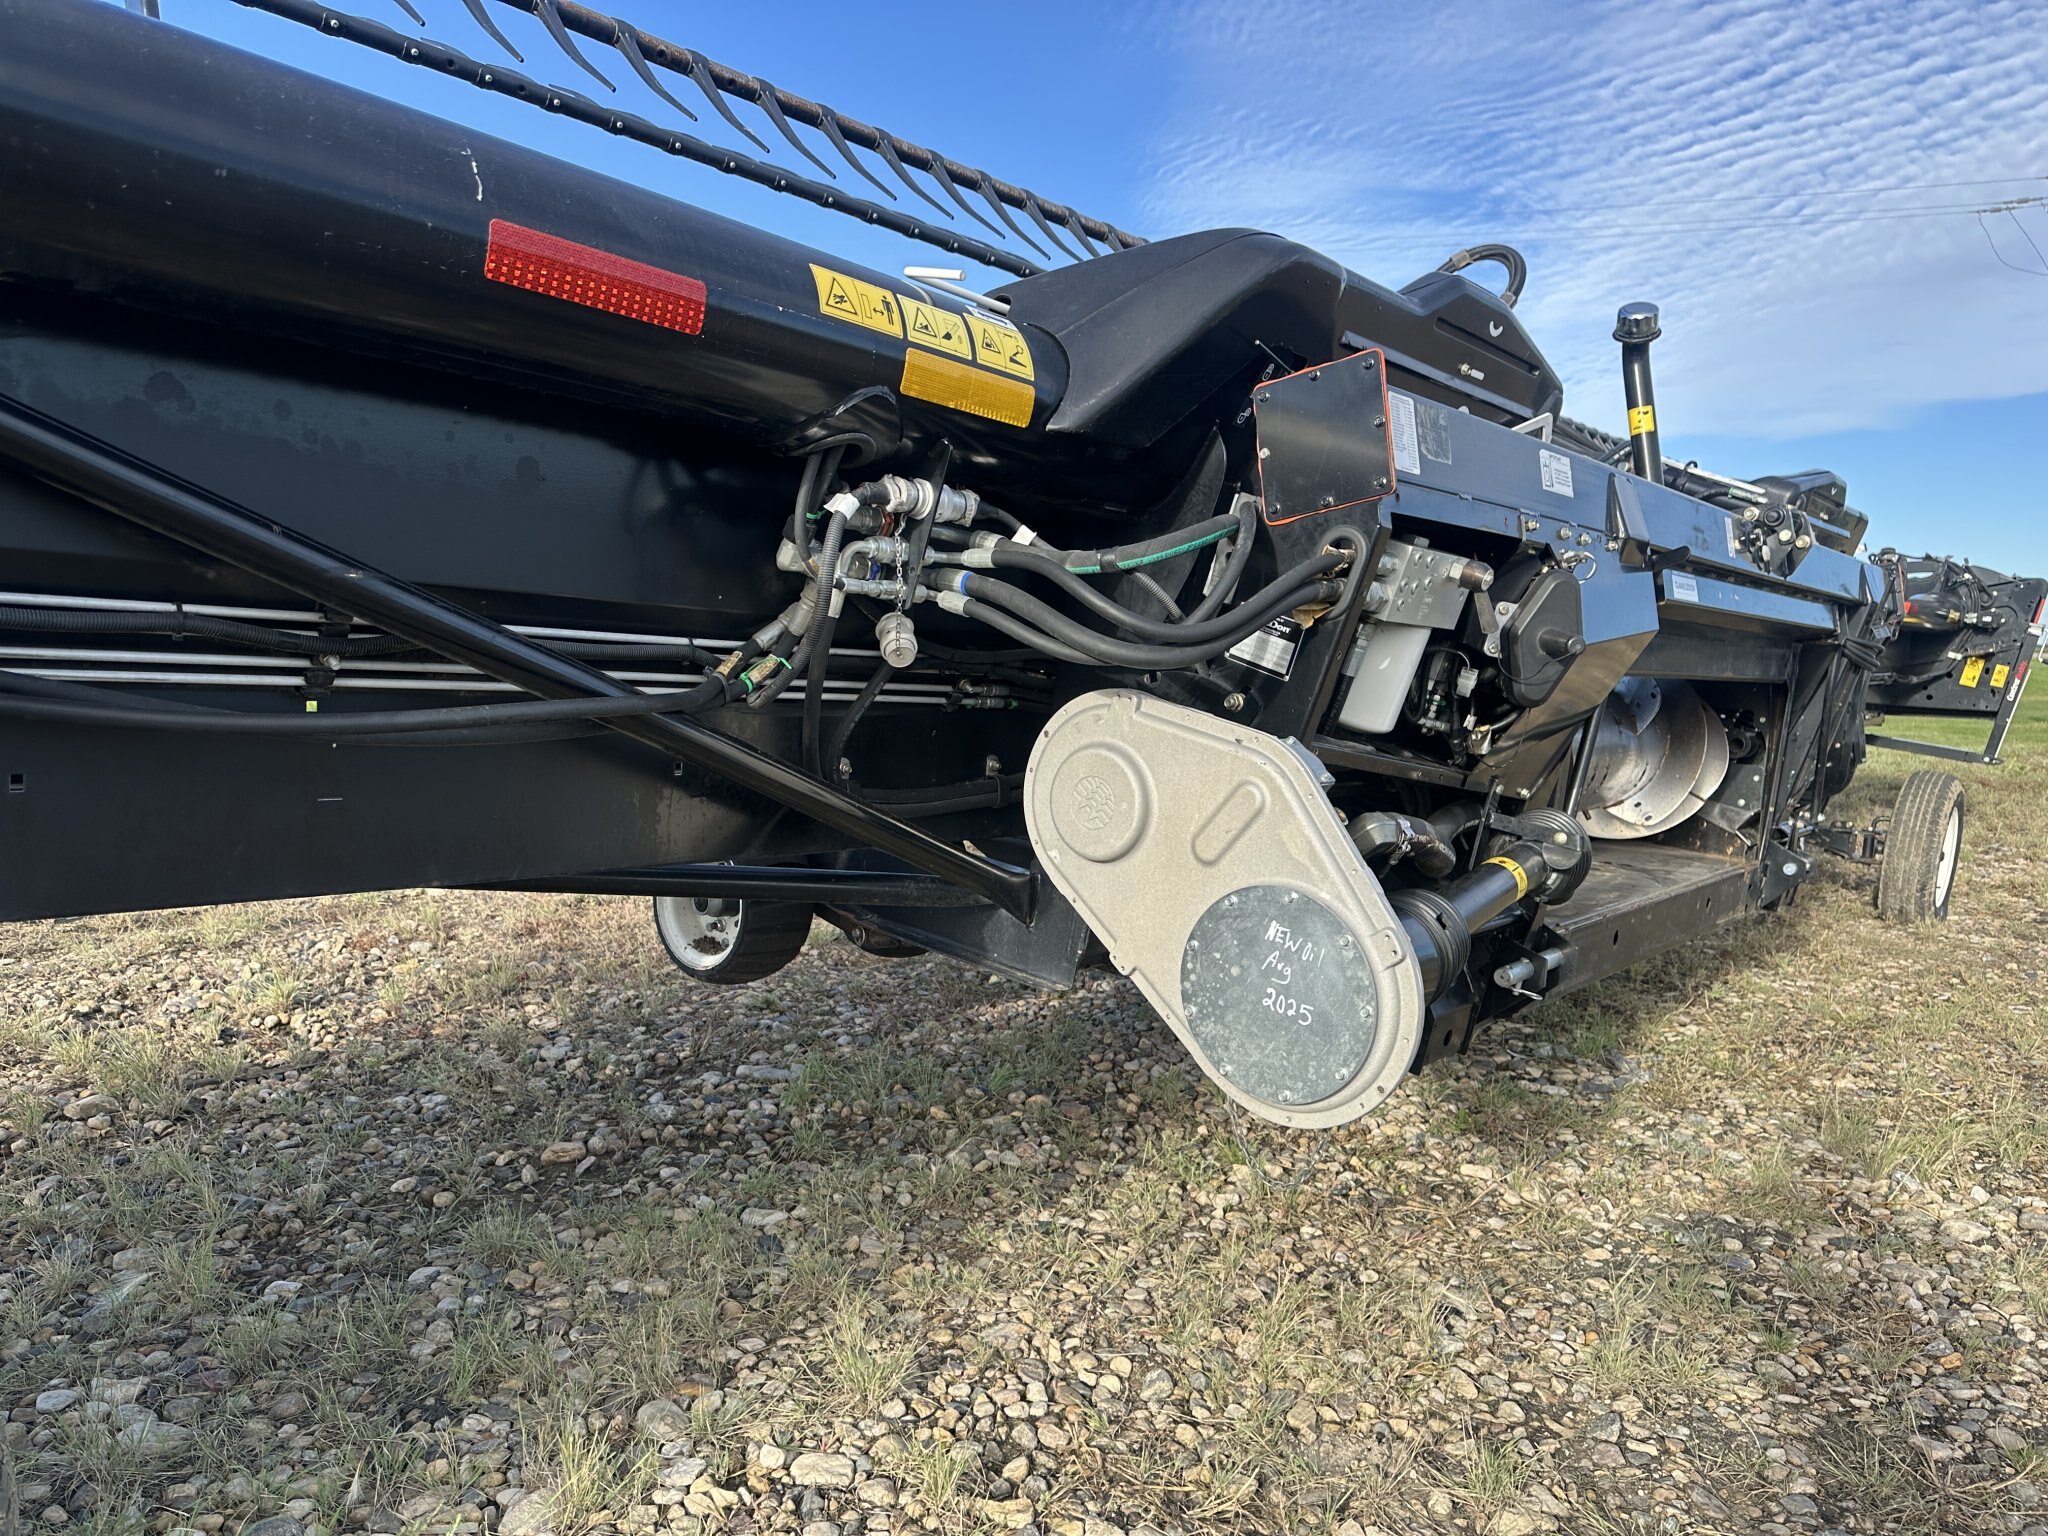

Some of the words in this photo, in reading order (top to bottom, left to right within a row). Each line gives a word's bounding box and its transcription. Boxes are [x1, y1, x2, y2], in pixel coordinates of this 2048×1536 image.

[1266, 619, 1292, 634] Don
[1264, 920, 1304, 952] NEW
[1262, 987, 1314, 1026] 2025
